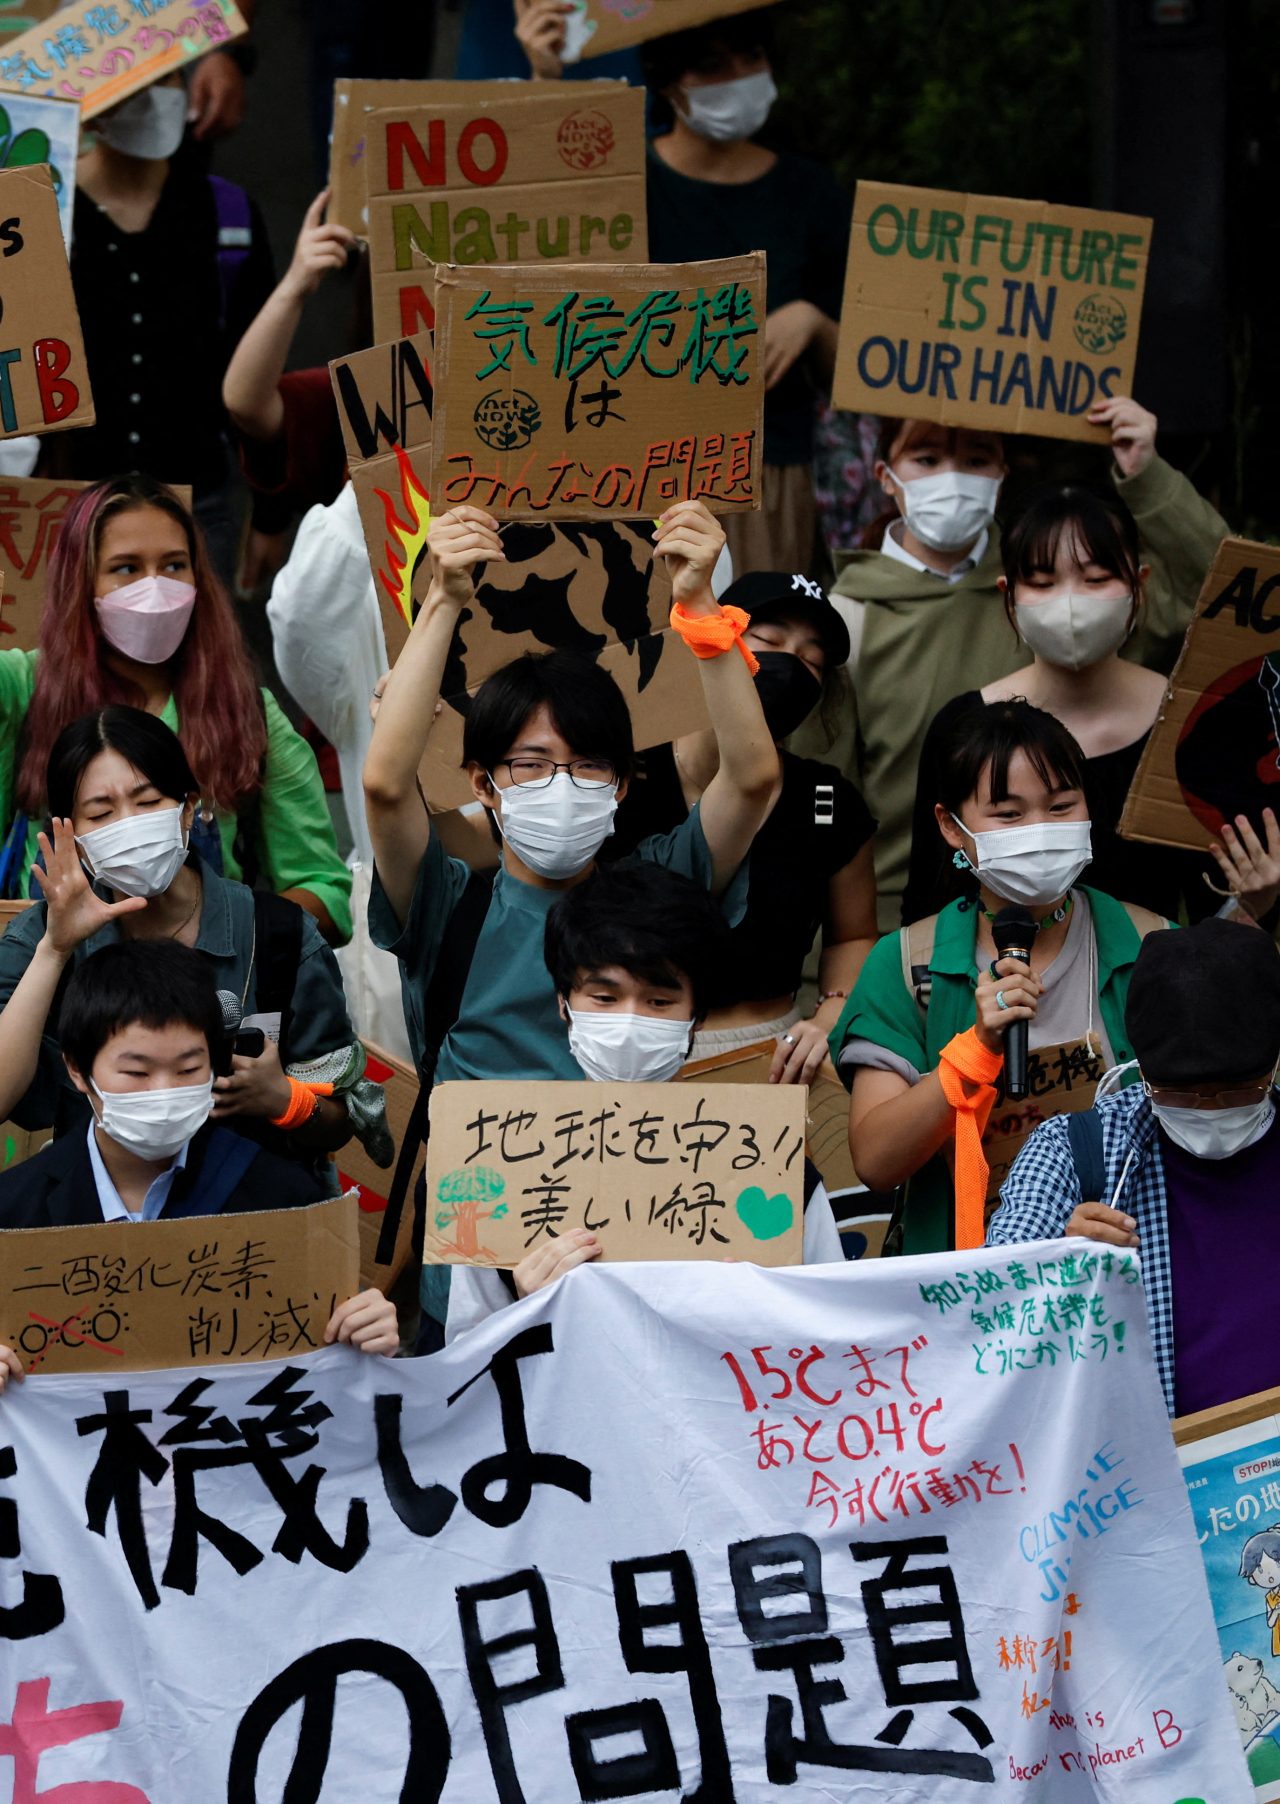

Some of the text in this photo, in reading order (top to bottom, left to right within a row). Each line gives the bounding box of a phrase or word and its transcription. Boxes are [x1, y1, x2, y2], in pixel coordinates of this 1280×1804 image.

[386, 117, 509, 191] NO
[391, 201, 634, 272] Nature
[866, 203, 1145, 292] OUR FUTURE
[463, 283, 760, 386] 気候危機
[936, 272, 1058, 342] IS IN
[33, 338, 79, 425] B
[564, 380, 626, 433] は
[856, 335, 1123, 417] OUR HANDS
[444, 430, 757, 512] みんなの問題
[520, 1173, 732, 1250] 美しい緑
[12, 1240, 277, 1300] 二酸化炭素
[1087, 1735, 1145, 1782] planet
[1152, 1708, 1183, 1750] B
